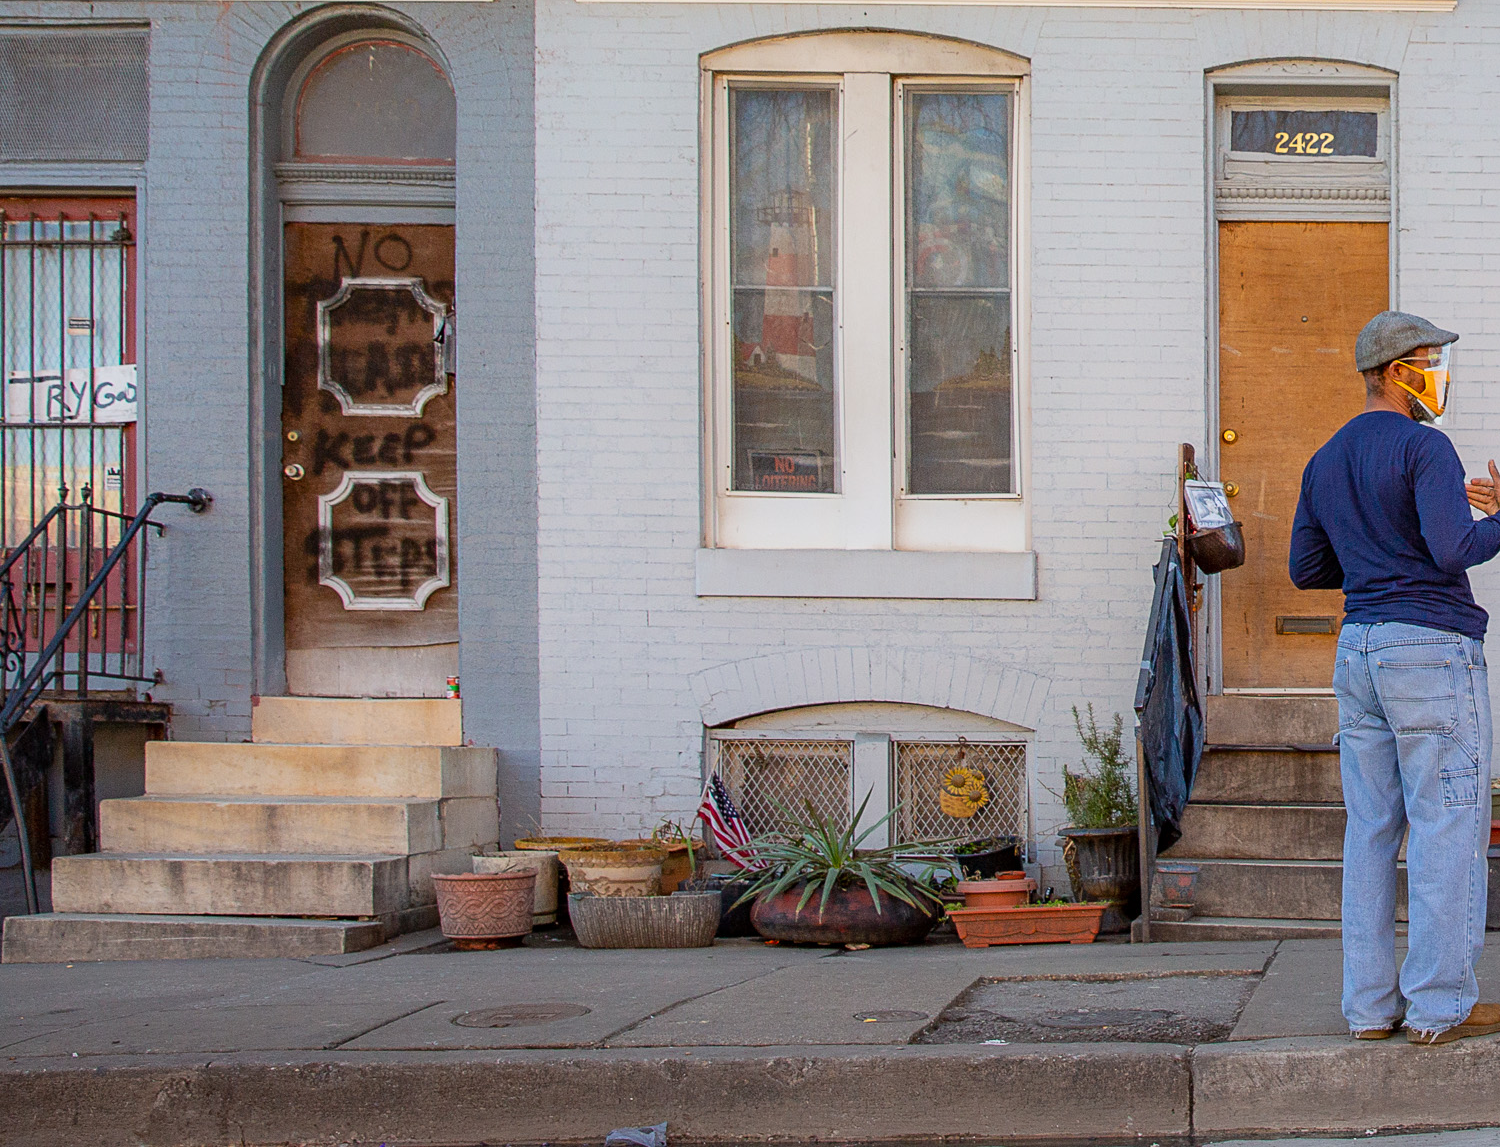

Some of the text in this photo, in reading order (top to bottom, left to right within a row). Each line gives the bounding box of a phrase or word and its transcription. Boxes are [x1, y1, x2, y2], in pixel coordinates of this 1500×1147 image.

[1275, 132, 1335, 154] 2422
[332, 229, 413, 280] NO
[312, 423, 436, 475] KEEP
[774, 456, 795, 473] NO
[353, 481, 418, 520] OFF
